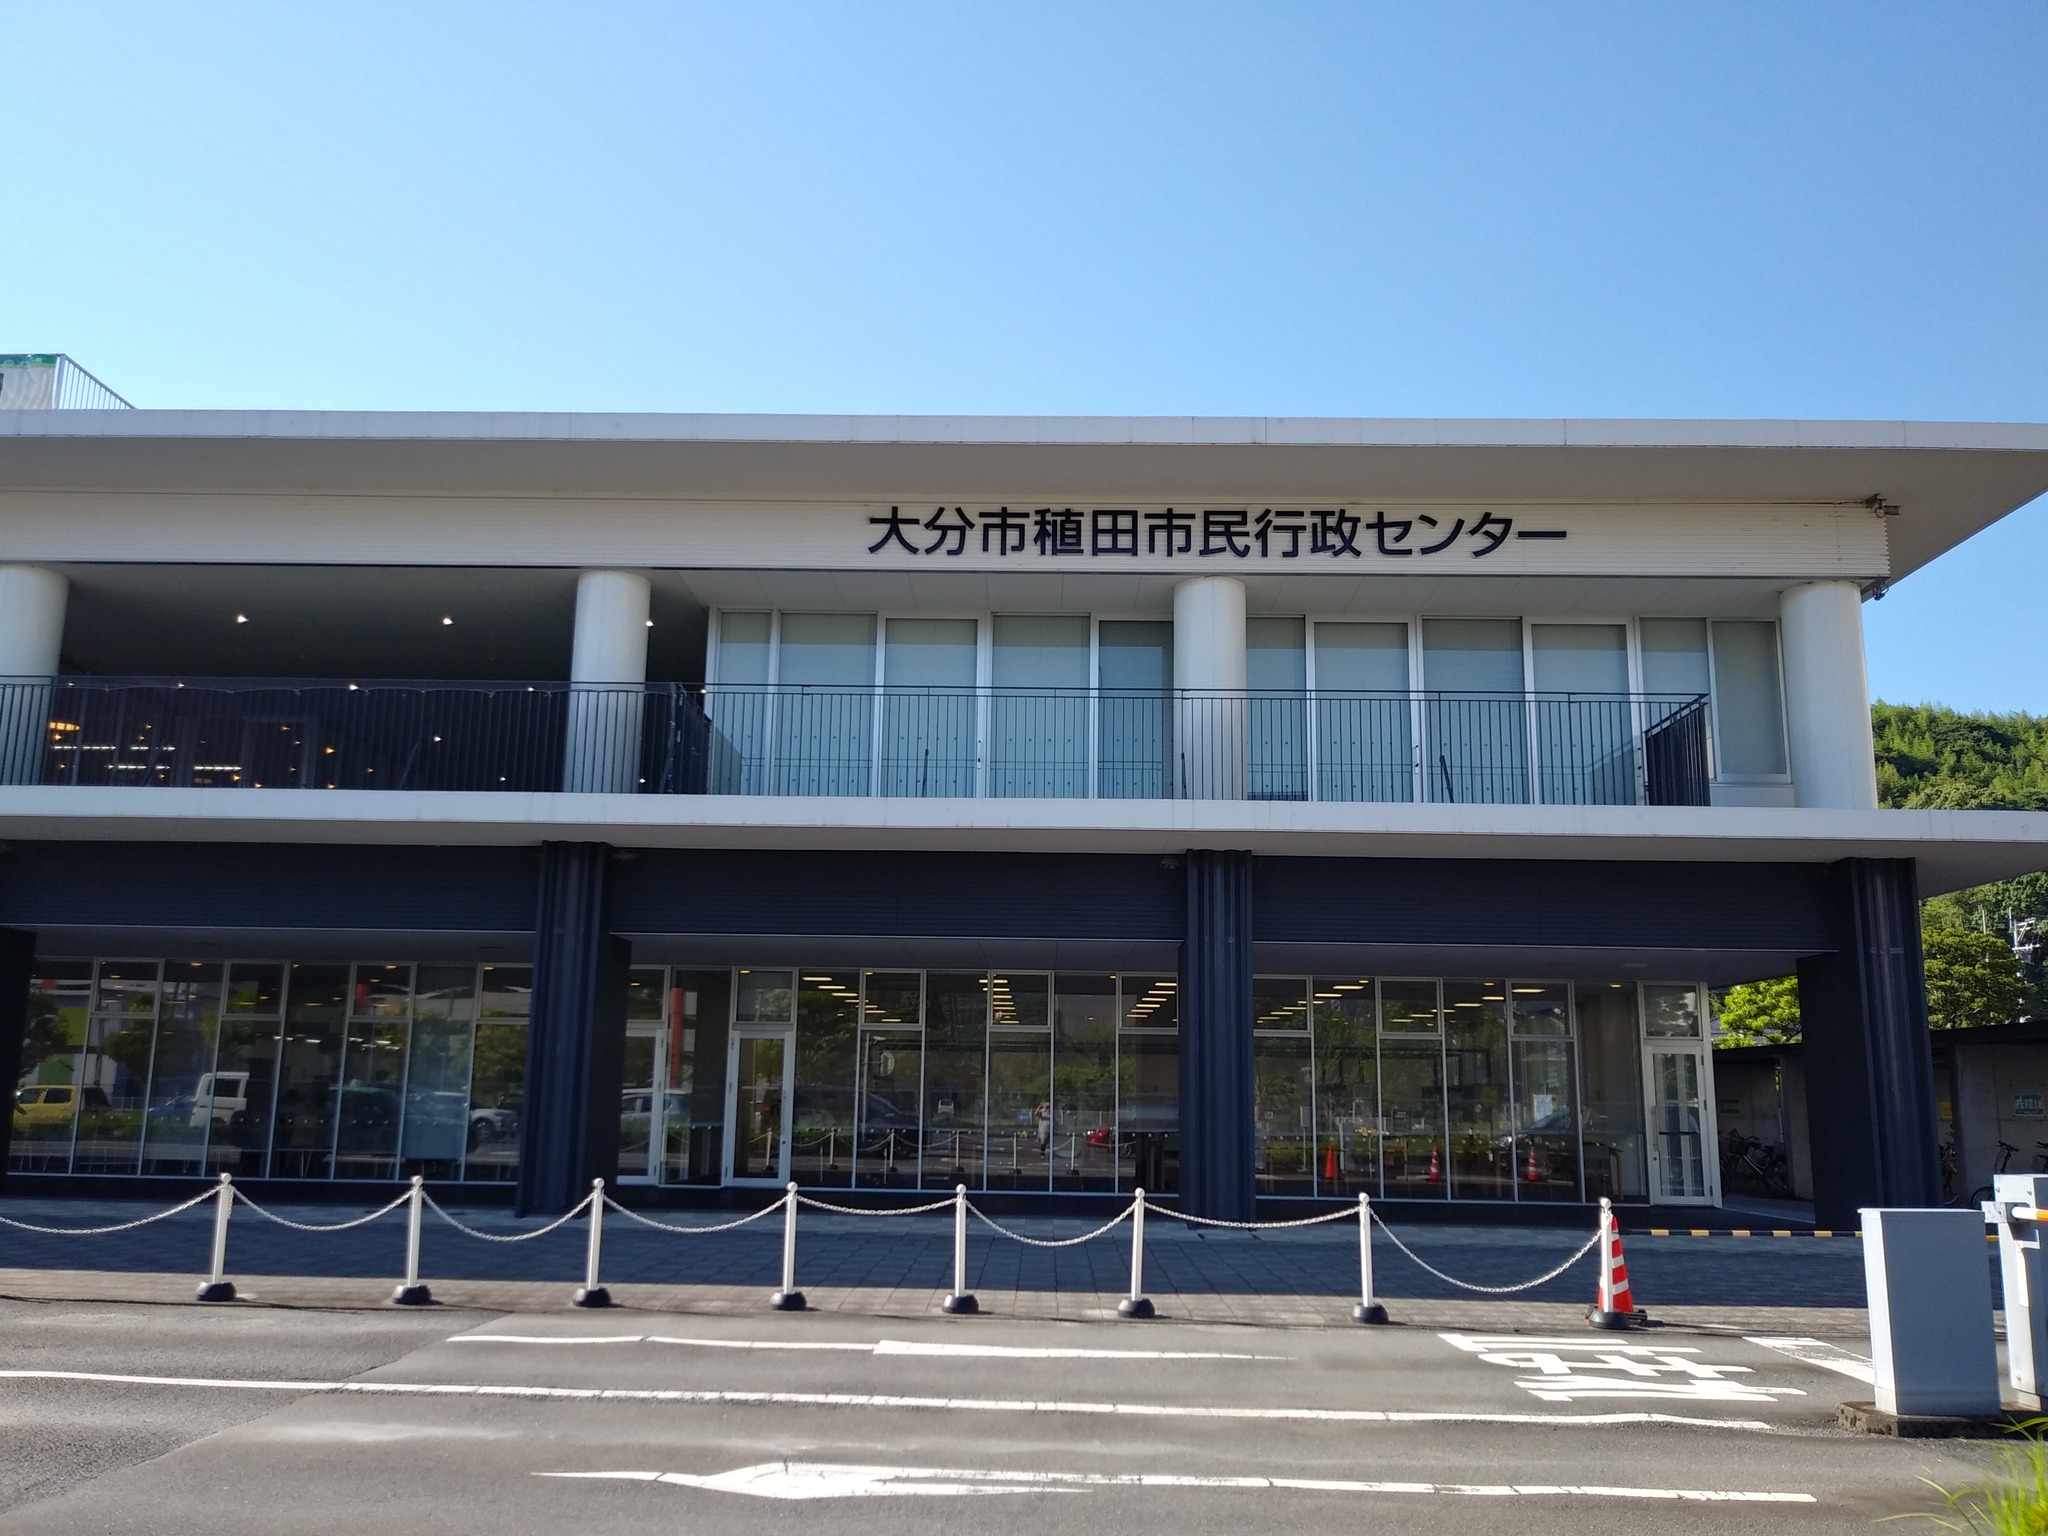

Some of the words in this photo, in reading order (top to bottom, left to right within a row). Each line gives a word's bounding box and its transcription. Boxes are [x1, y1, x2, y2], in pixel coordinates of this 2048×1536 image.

[869, 506, 1567, 559] 大分市稙田市民行政センター
[1437, 1333, 1809, 1402] 止まれ
